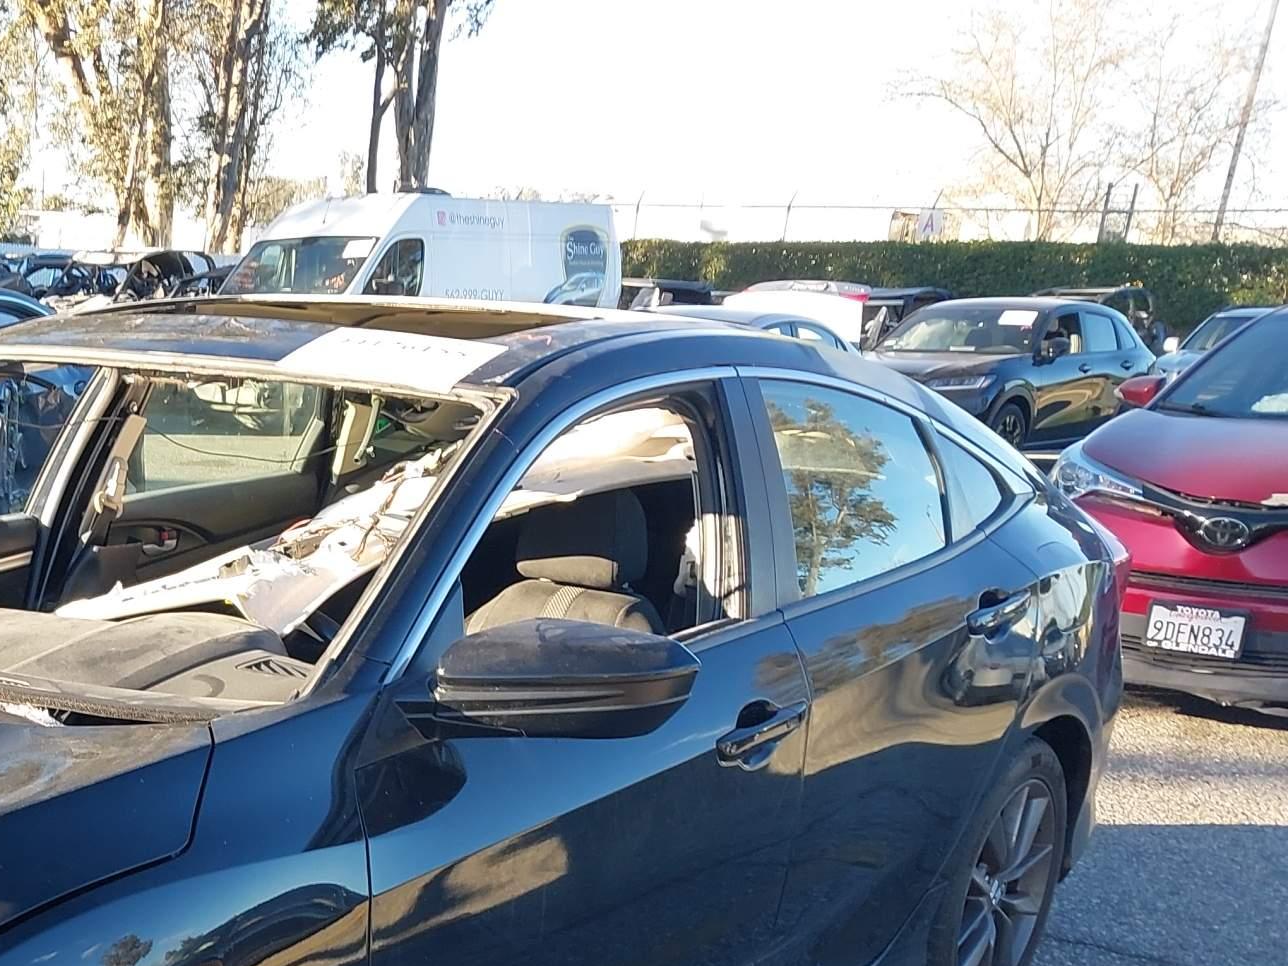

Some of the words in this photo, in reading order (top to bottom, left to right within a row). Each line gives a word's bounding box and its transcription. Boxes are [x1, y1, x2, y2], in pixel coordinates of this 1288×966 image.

[922, 212, 934, 232] A
[566, 241, 589, 260] Shine
[589, 241, 604, 258] Guy
[1175, 604, 1221, 620] TOYOTA
[1161, 640, 1236, 659] GLENDALE
